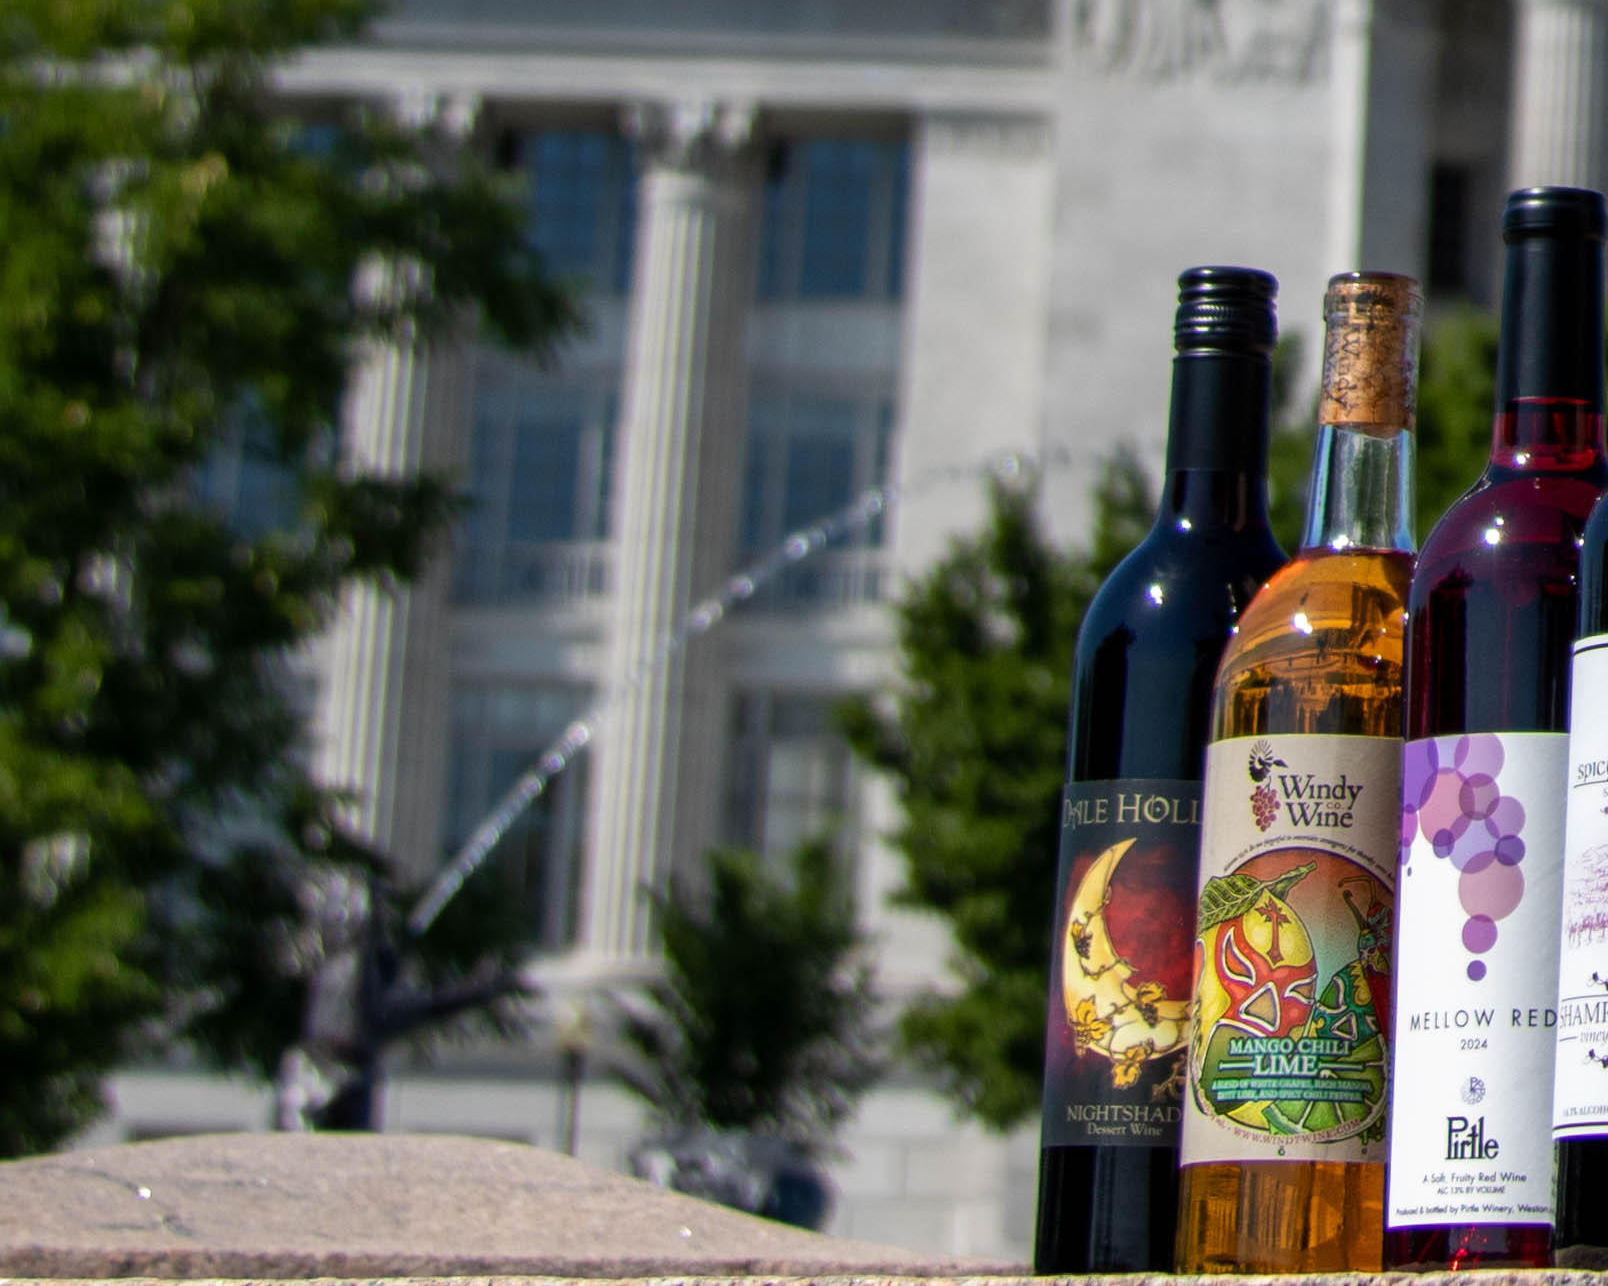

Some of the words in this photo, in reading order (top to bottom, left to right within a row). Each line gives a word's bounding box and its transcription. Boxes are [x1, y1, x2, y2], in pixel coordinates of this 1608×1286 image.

[1278, 775, 1363, 810] Windy
[1286, 802, 1353, 827] Wine
[1410, 1009, 1495, 1031] MELLOW
[1512, 1009, 1557, 1027] RED
[1229, 1038, 1293, 1055] MANGO
[1298, 1038, 1350, 1055] CHILI
[1461, 1039, 1488, 1051] 2024
[1252, 1054, 1319, 1076] LIME
[1445, 1116, 1499, 1160] Pirtle
[1479, 1172, 1496, 1182] Red
[1500, 1171, 1527, 1182] Wine
